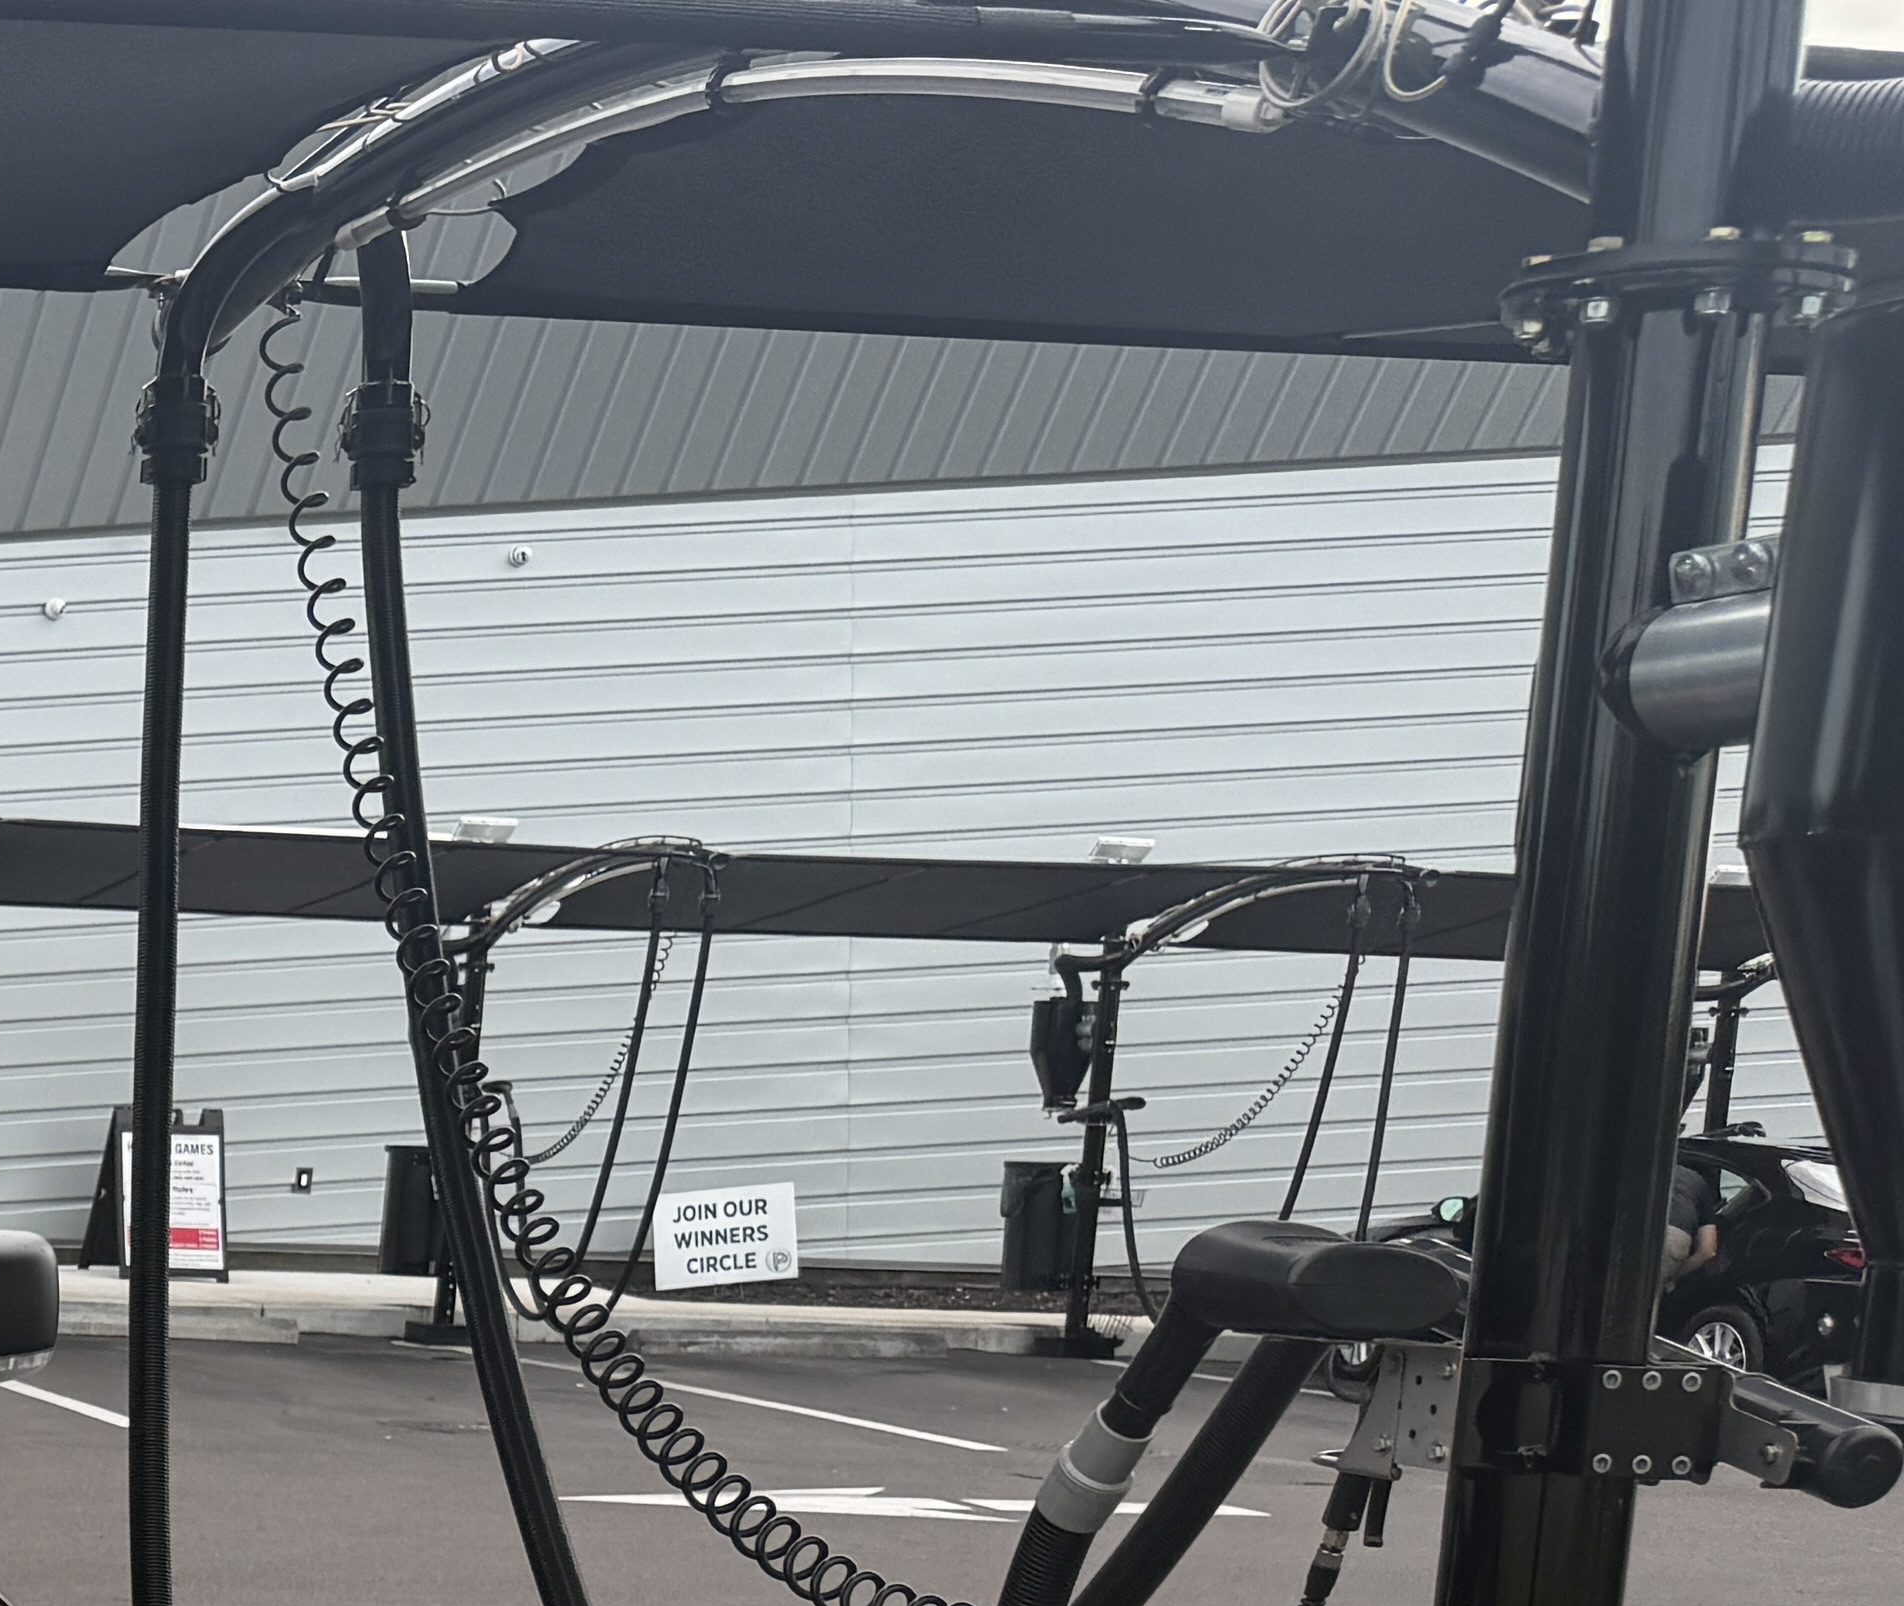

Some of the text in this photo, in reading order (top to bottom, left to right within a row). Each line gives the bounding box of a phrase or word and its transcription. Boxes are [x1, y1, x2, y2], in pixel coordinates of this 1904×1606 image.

[175, 1143, 214, 1156] GAMES
[672, 1198, 768, 1223] JOIN OUR
[674, 1224, 769, 1249] WINNERS
[686, 1252, 757, 1274] CIRCLE
